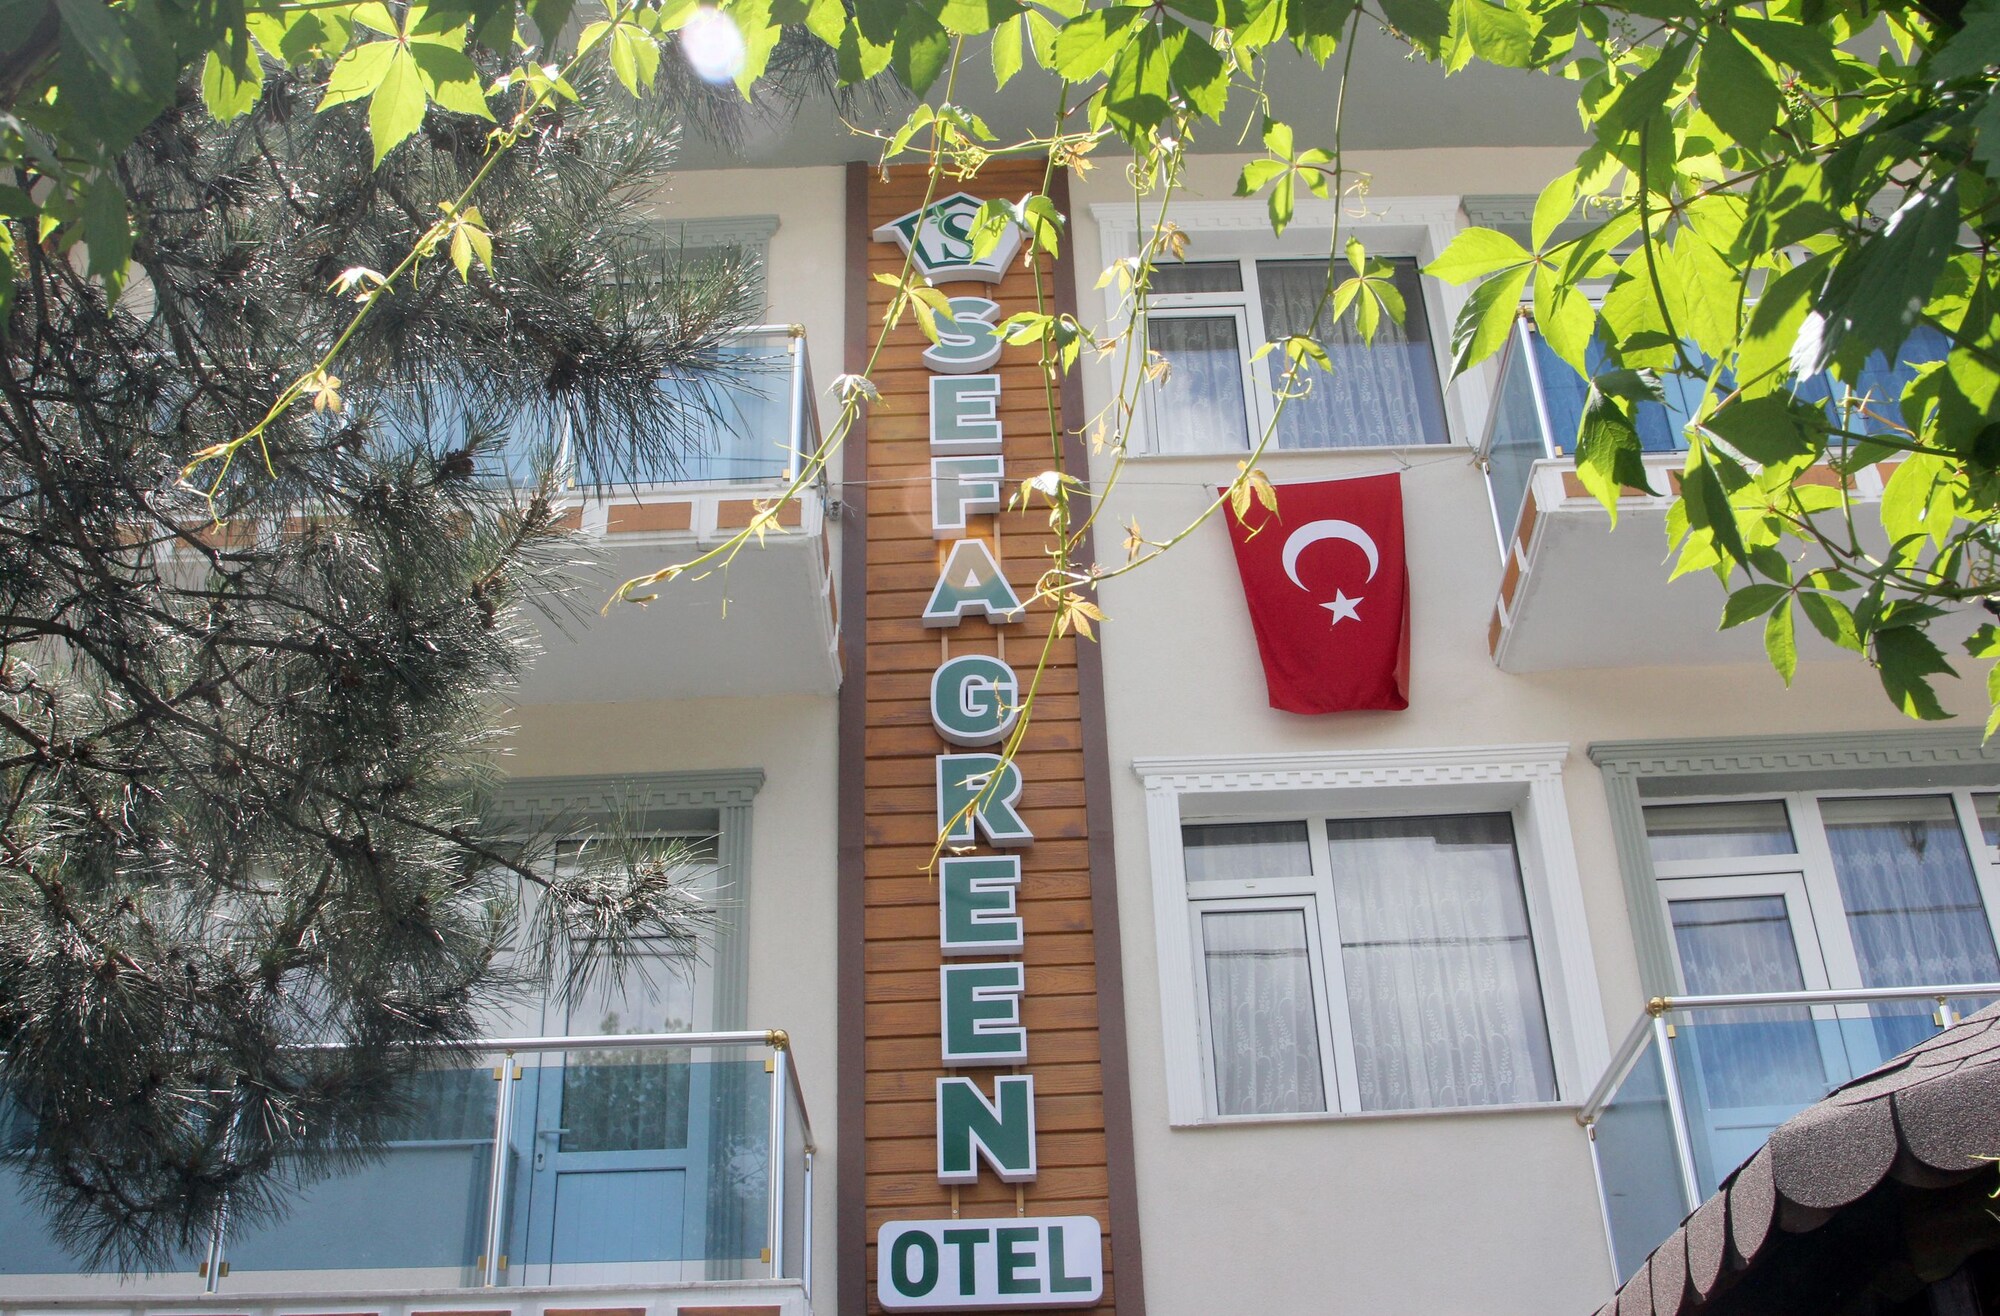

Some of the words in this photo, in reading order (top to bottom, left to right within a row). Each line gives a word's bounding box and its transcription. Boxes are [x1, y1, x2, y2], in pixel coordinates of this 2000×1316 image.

[922, 296, 1025, 627] SEFA
[930, 654, 1037, 1184] GREEN
[890, 1226, 1092, 1298] OTEL
